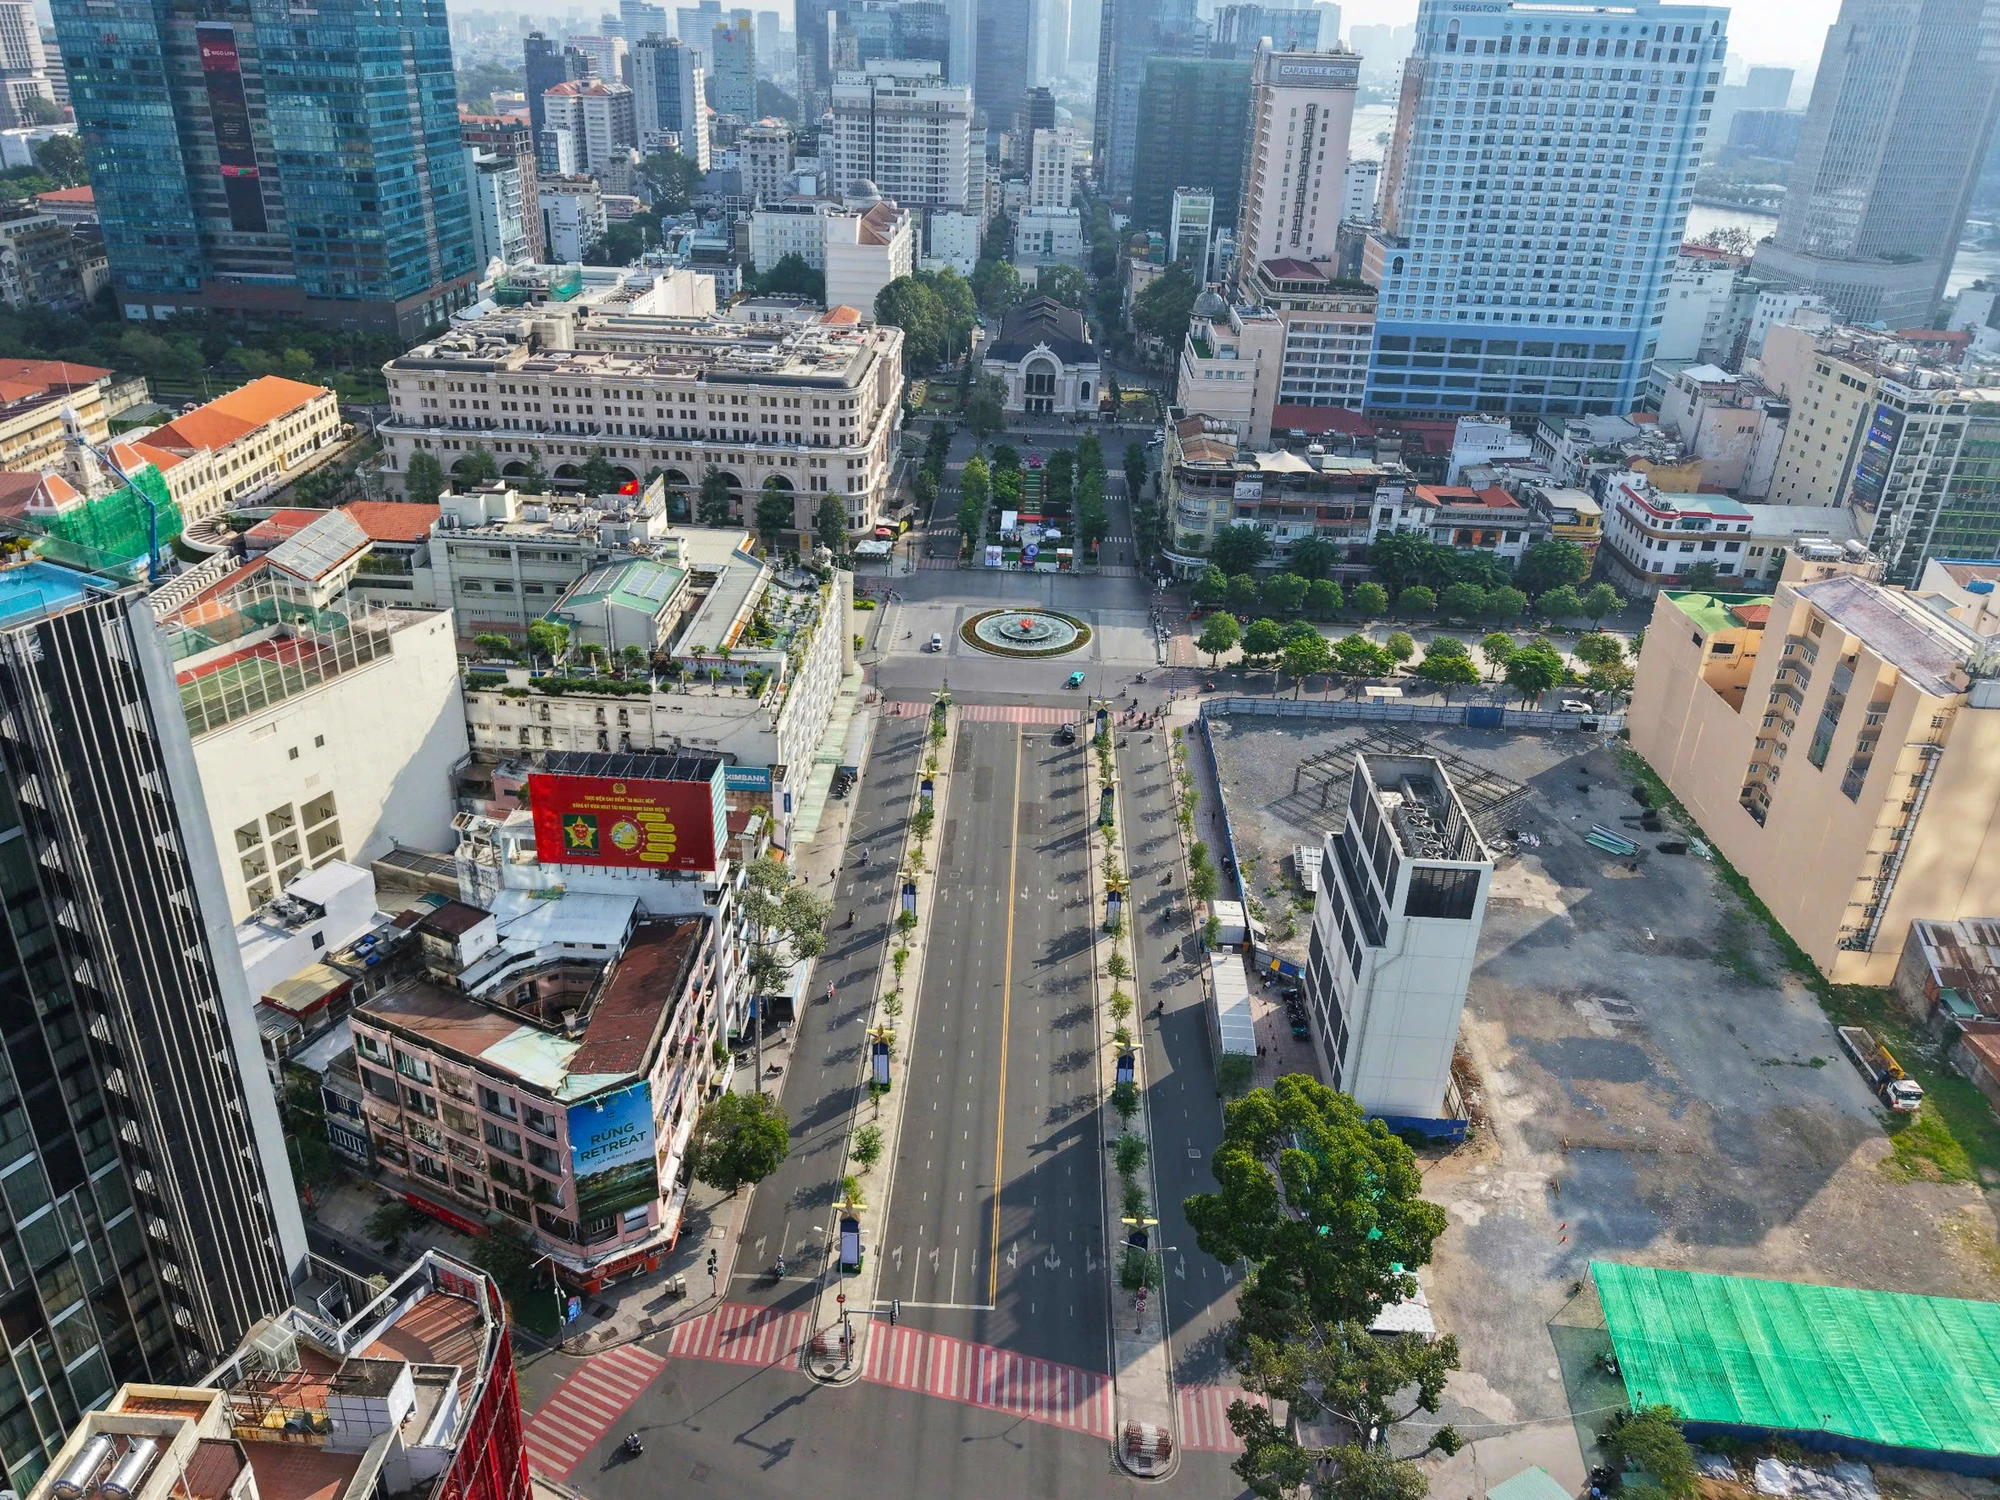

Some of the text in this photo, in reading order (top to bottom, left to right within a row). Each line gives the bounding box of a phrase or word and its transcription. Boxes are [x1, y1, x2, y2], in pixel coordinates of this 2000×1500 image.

[1452, 4, 1502, 13] SHERATON
[1283, 66, 1355, 76] CARAVELLE HOTEL
[1956, 492, 1974, 500] YES
[725, 773, 766, 782] XIMBANK
[580, 1131, 647, 1162] RETREAT
